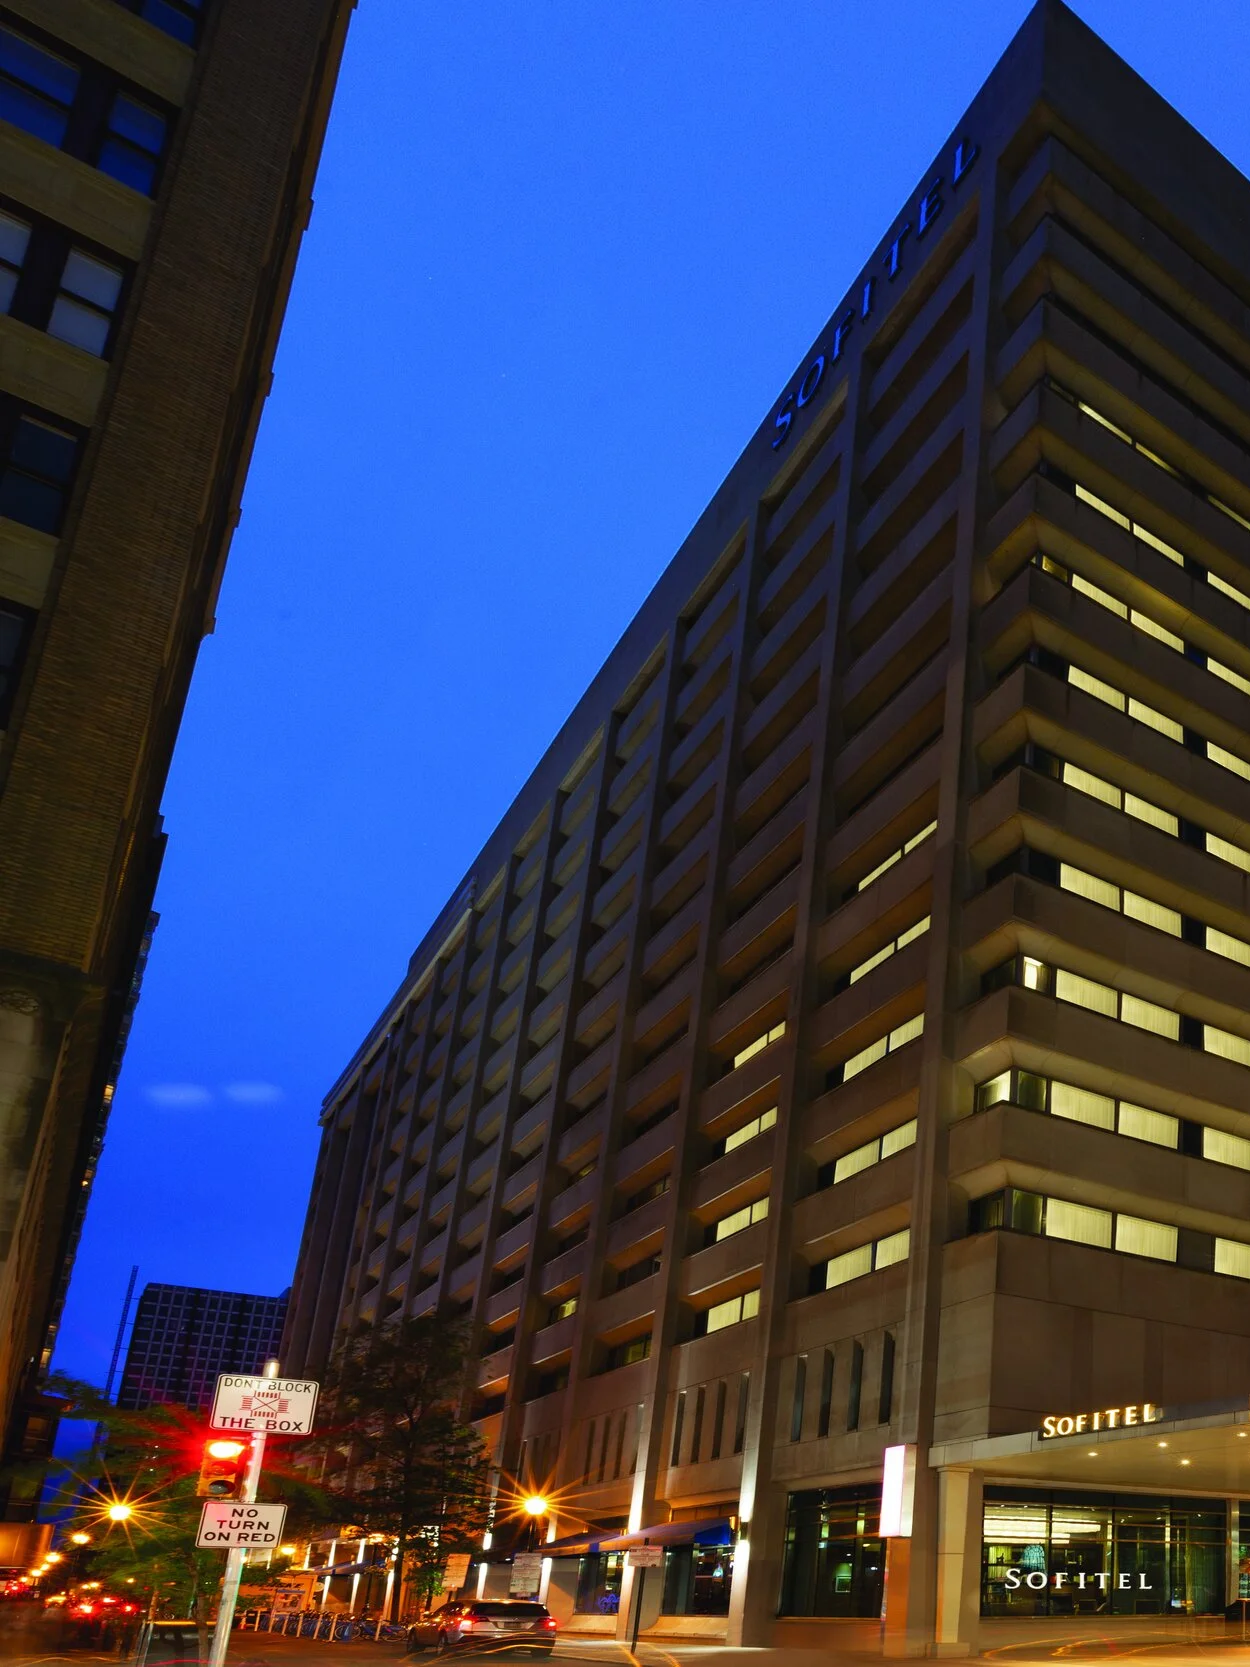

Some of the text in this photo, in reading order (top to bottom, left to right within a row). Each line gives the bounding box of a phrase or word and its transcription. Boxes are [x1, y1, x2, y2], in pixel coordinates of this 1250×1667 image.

[771, 137, 979, 450] SOFITEL
[268, 1381, 312, 1394] BLOCK
[220, 1416, 304, 1432] THE BOX
[1042, 1403, 1156, 1438] SOFITEL
[231, 1508, 258, 1518] NO
[216, 1520, 269, 1530] TURN
[204, 1532, 276, 1543] ON RED
[1004, 1567, 1153, 1590] SOFITEL
